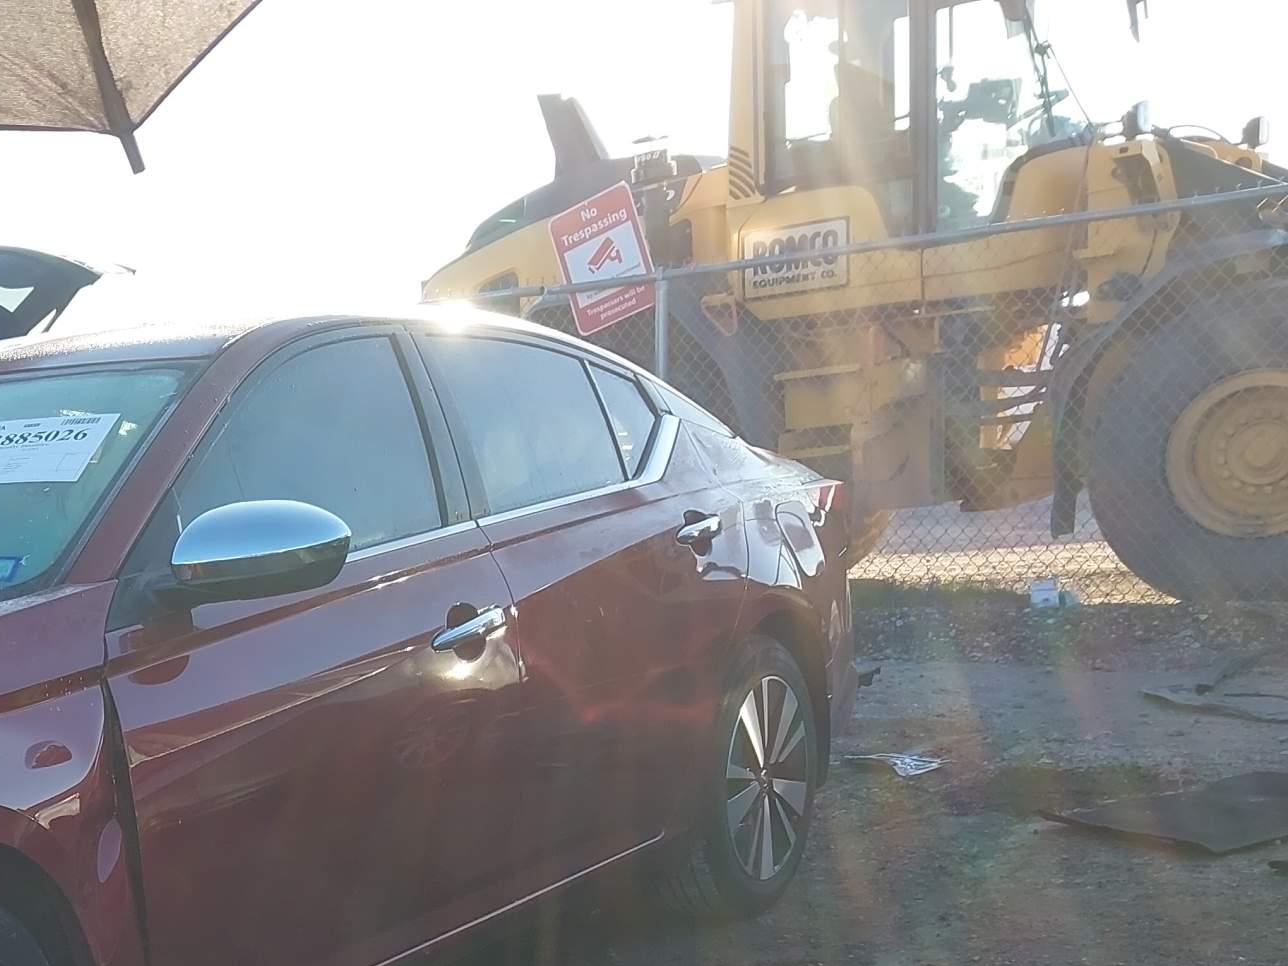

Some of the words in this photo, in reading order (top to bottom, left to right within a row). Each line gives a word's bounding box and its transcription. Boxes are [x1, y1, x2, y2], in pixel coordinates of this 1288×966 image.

[560, 207, 628, 247] Trespassing
[580, 207, 598, 222] No
[752, 229, 839, 276] ROMCO
[752, 271, 817, 289] EQUIPMENT
[586, 295, 624, 317] Trespassers
[624, 288, 636, 299] will
[599, 297, 637, 321] prosecuted
